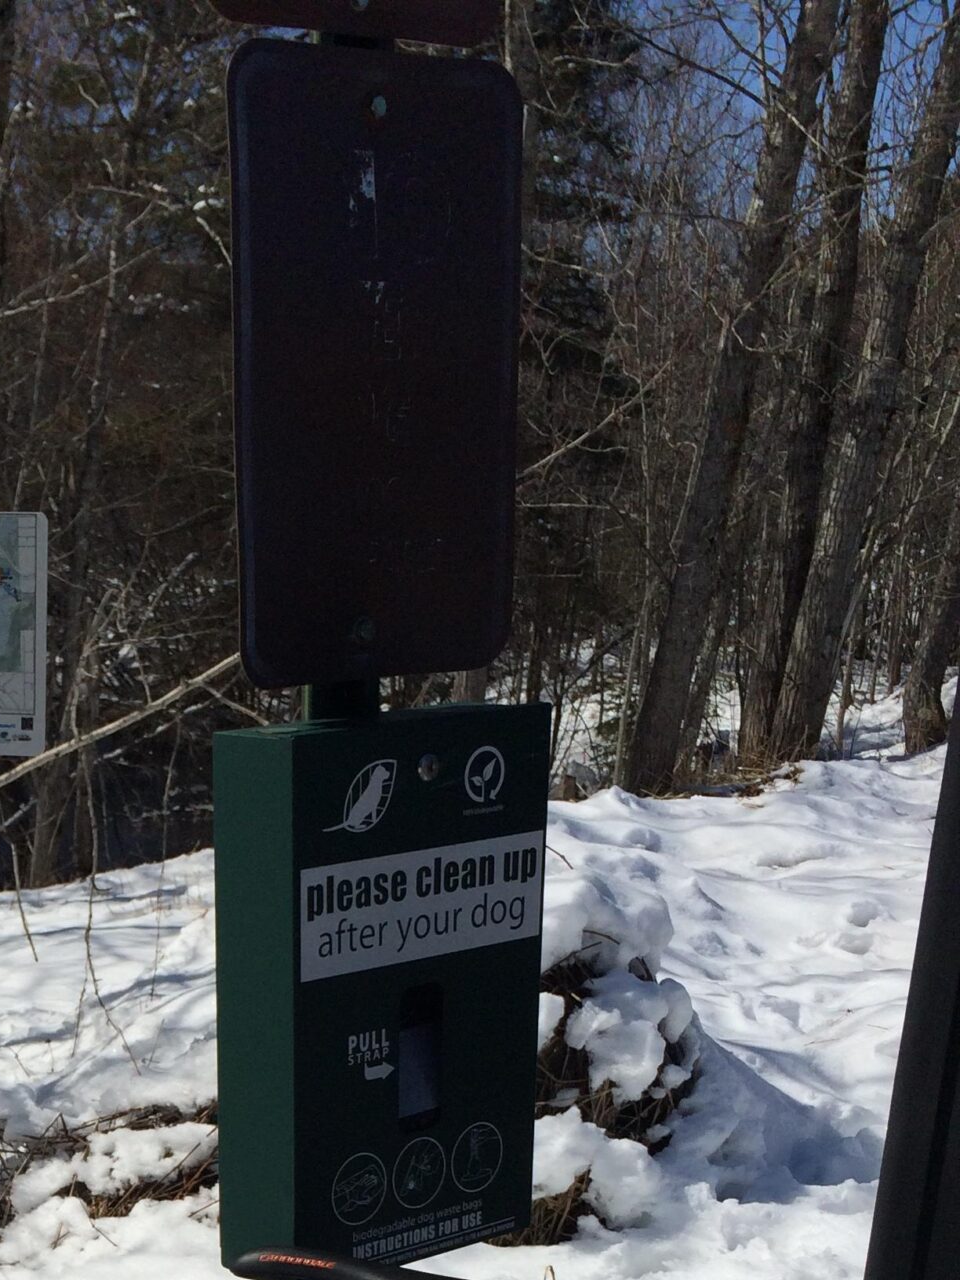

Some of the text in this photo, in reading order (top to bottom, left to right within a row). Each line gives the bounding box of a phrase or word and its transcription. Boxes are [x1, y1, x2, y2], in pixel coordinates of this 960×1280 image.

[307, 847, 537, 922] please clean up
[318, 893, 525, 958] after your dog
[347, 1047, 390, 1066] STRAP
[348, 1028, 390, 1055] PULL
[352, 1199, 483, 1243] biodegradable dog waste bags
[352, 1224, 436, 1260] INSTRUCTIONS
[438, 1216, 459, 1237] FOR
[462, 1210, 483, 1229] USE
